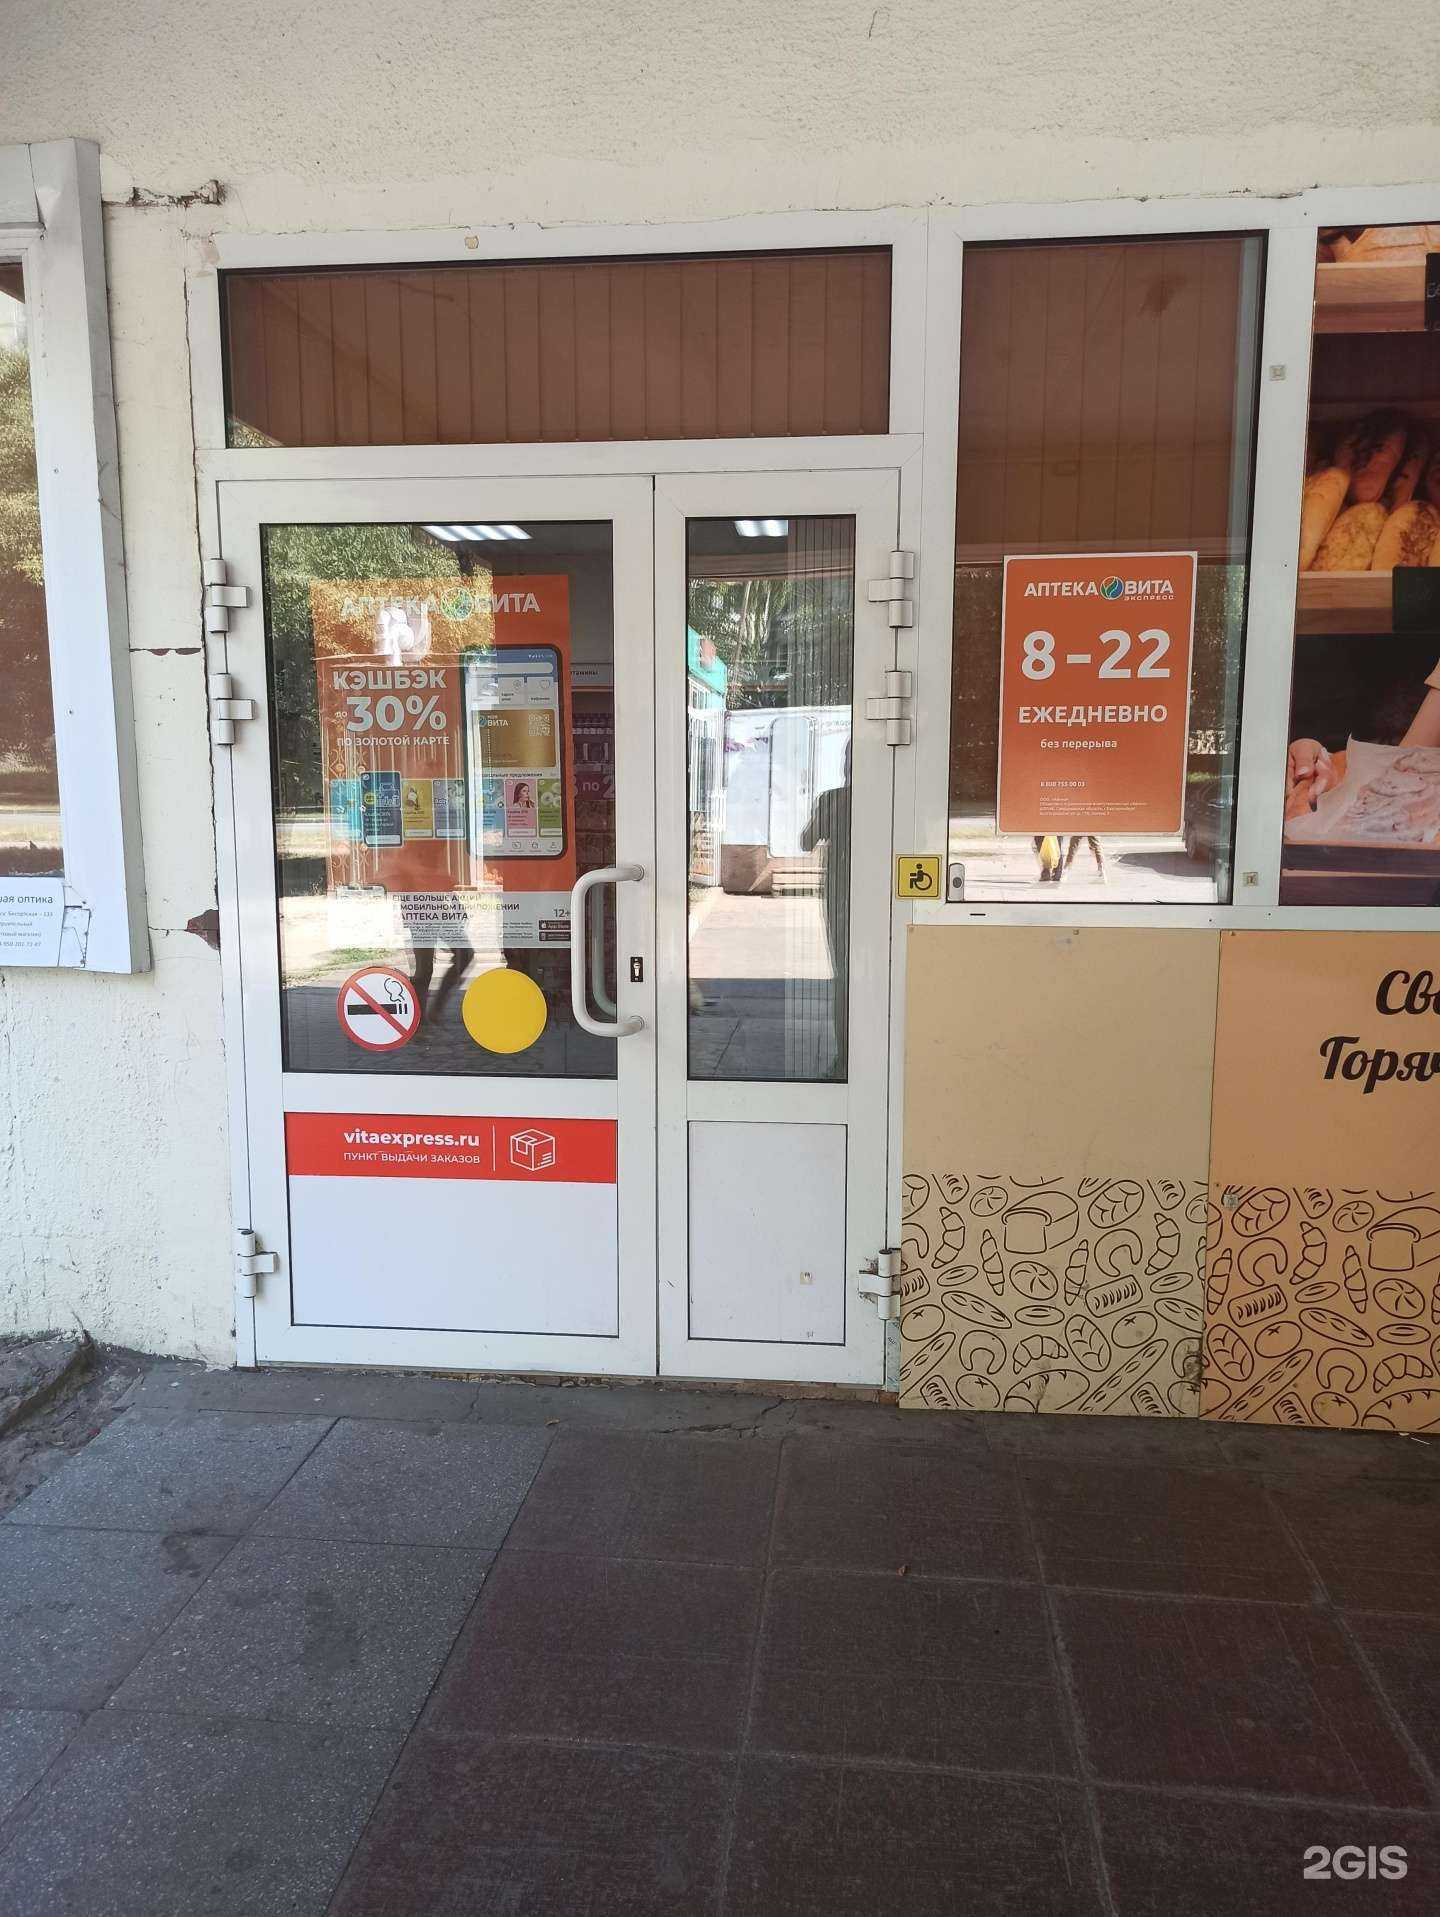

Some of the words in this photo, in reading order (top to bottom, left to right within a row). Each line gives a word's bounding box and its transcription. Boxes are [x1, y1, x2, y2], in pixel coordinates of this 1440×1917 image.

[1023, 582, 1099, 597] АПТЕКА
[1124, 580, 1174, 594] ВИТА
[473, 592, 542, 613] ВИТА
[332, 669, 448, 690] КЭШБЭК
[346, 694, 447, 732] 30%
[1018, 704, 1168, 727] ЕЖЕДНЕВНО
[337, 738, 352, 746] ПО
[355, 735, 410, 746] ЗОЛОТОЙ
[413, 736, 450, 745] КАРТЕ
[1040, 739, 1060, 748] без
[1062, 741, 1117, 751] перерыва
[17, 895, 54, 904] оптика
[413, 894, 449, 902] БОЛЬШЕ
[400, 903, 457, 911] МОБИЛЬНОМ
[553, 908, 571, 918] 12+
[1375, 969, 1440, 1015] Св
[1320, 1036, 1440, 1095] Горя
[343, 1128, 480, 1148] vitaexpress.ru
[343, 1152, 378, 1162] ПУНКТ
[381, 1153, 428, 1164] ВЫДАЧИ
[430, 1154, 480, 1164] ЗАКАЗОВ
